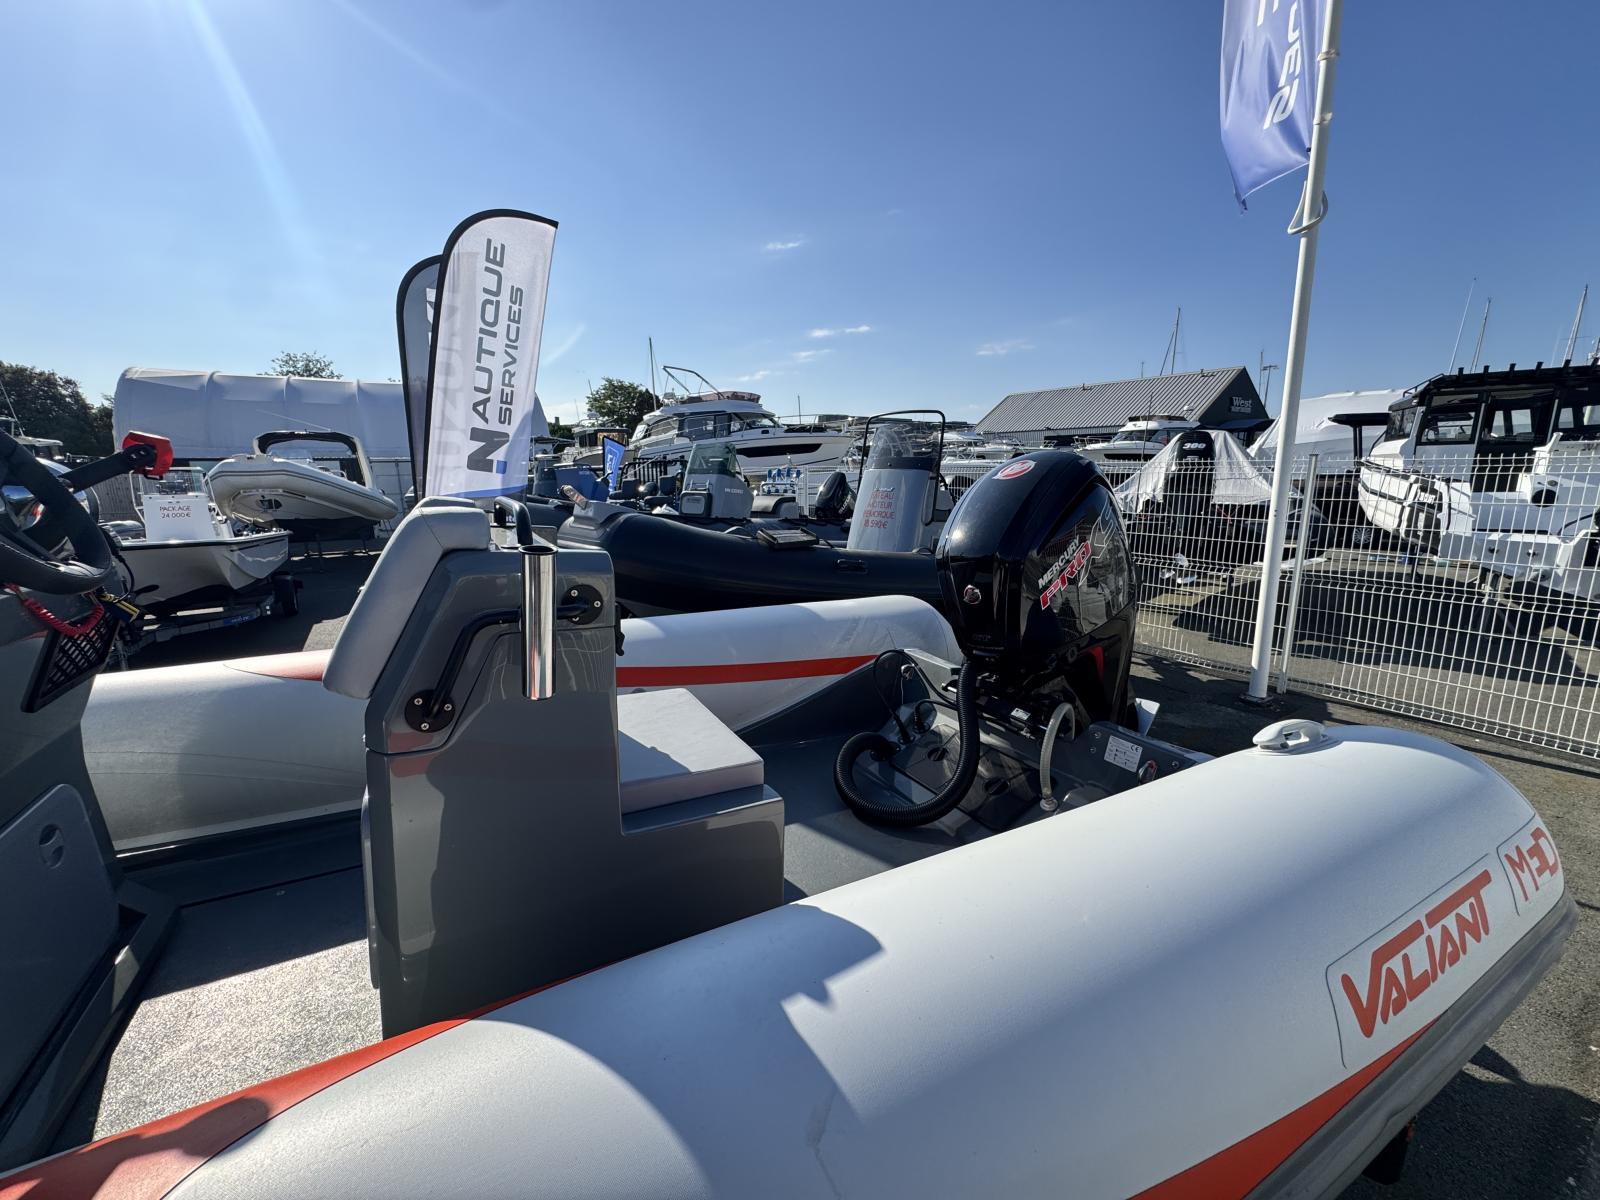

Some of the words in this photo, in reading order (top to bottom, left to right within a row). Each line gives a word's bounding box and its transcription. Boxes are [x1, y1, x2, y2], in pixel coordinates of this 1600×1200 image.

[498, 285, 524, 426] SERVICES
[1231, 396, 1252, 407] West
[1038, 534, 1080, 589] MERCURY
[1040, 540, 1092, 611] PRO
[1340, 868, 1493, 1038] VALIANT
